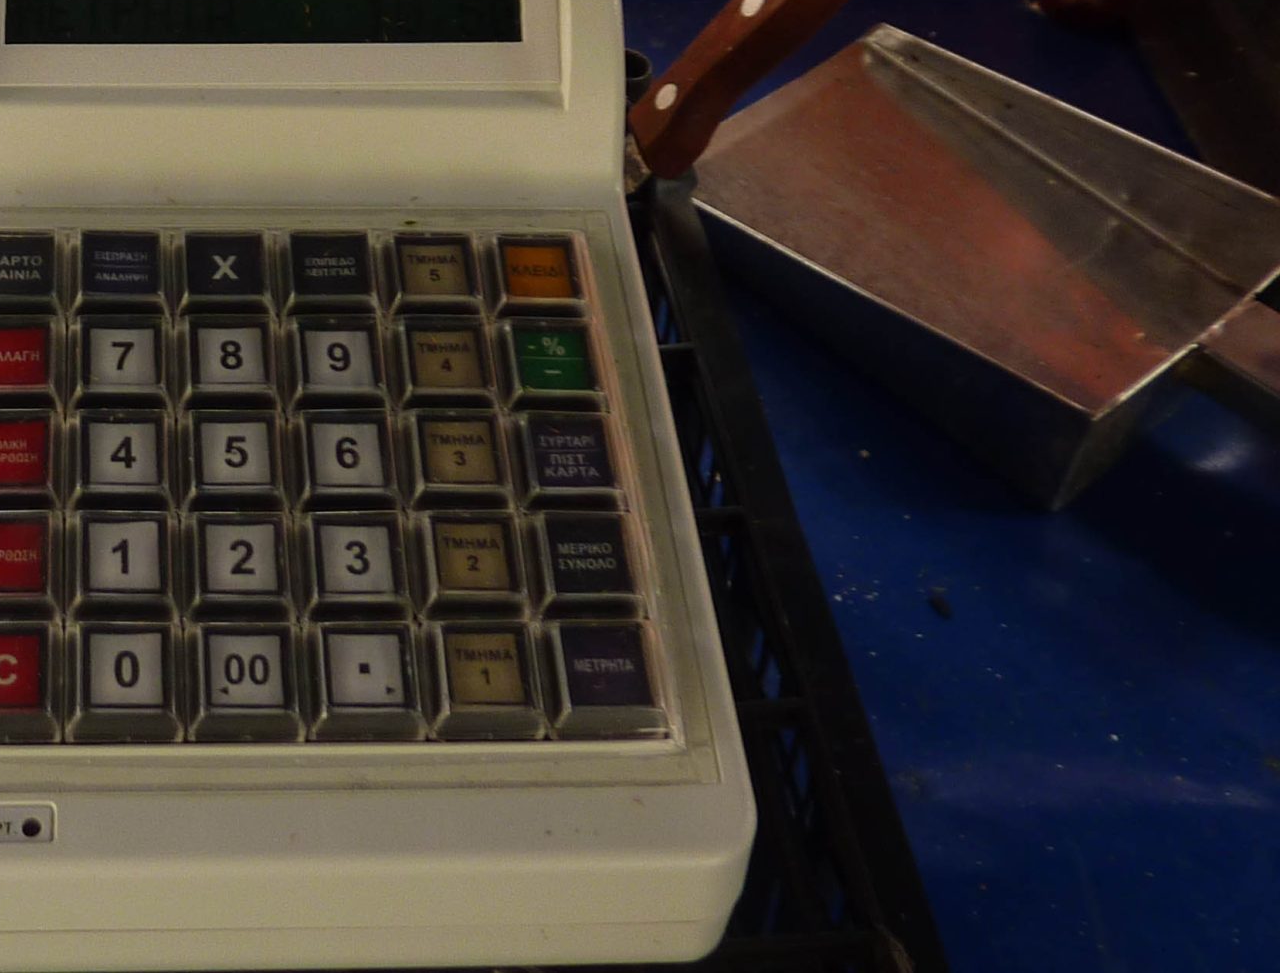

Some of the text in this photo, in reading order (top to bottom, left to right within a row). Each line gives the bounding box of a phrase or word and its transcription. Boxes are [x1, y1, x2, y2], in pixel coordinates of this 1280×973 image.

[408, 254, 458, 266] ΤΜΗΜΑ
[429, 269, 441, 282] 5
[111, 341, 135, 370] 7
[219, 340, 243, 370] 8
[419, 342, 470, 354] ΤΜΗΜΑ
[326, 342, 351, 372] 9
[440, 358, 453, 372] 4
[431, 434, 486, 446] ΤΜΗΜΑ
[110, 436, 136, 469] 4
[224, 436, 248, 468] 5
[335, 437, 360, 469] 6
[454, 451, 466, 467] 3
[544, 466, 600, 478] ΚΑΡΤΑ
[443, 537, 500, 550] ΤΜΗΜΑ
[558, 542, 613, 555] ΜΕΡΙΚΟ
[112, 539, 130, 575] 1
[229, 539, 256, 575] 2
[344, 540, 370, 575] 3
[467, 556, 479, 571] 2
[558, 557, 617, 570] ΣΥΝΟΛΟ
[455, 648, 514, 662] ΤΜΗΜΑ
[114, 651, 140, 688] 0
[224, 654, 270, 686] 00
[573, 659, 636, 673] ΜΕΤΡΗΤΑ
[481, 668, 491, 685] 1
